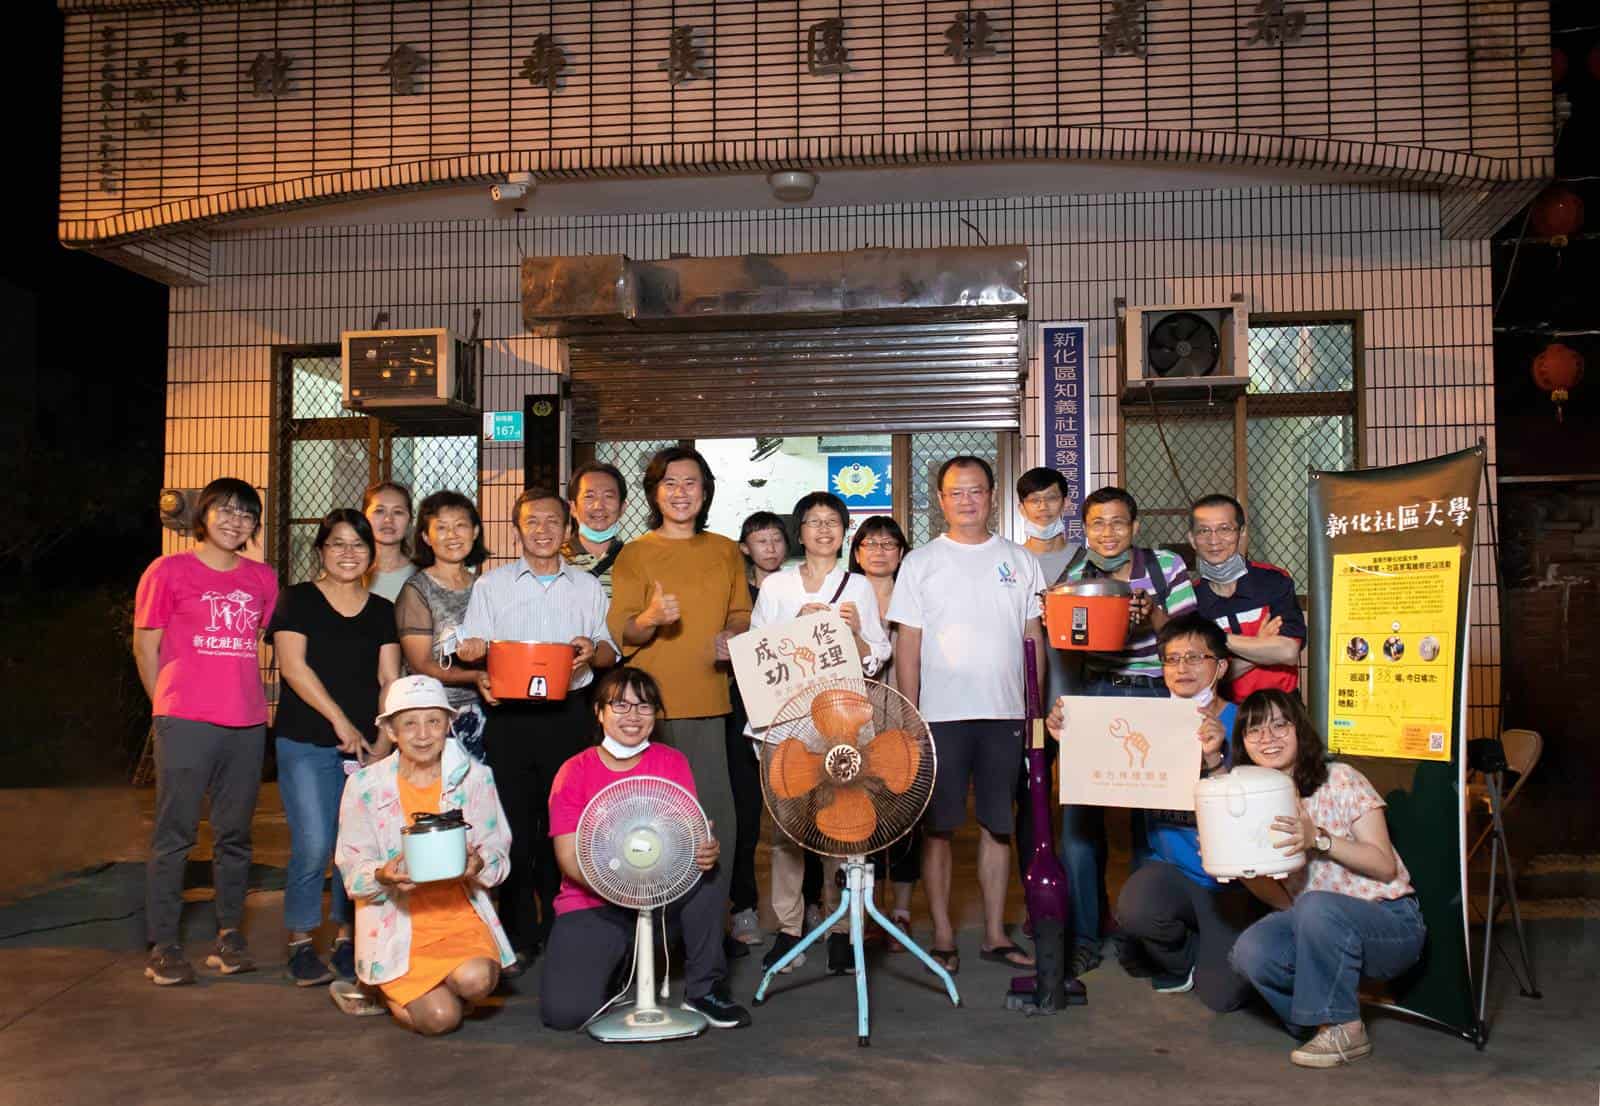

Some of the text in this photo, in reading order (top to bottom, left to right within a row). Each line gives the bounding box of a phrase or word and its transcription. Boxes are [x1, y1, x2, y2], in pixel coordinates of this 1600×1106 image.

[1053, 332, 1080, 516] 新化區知義社區發展
[1326, 496, 1472, 539] 新化社區大學
[754, 637, 790, 686] 成功
[812, 621, 848, 670] 修理
